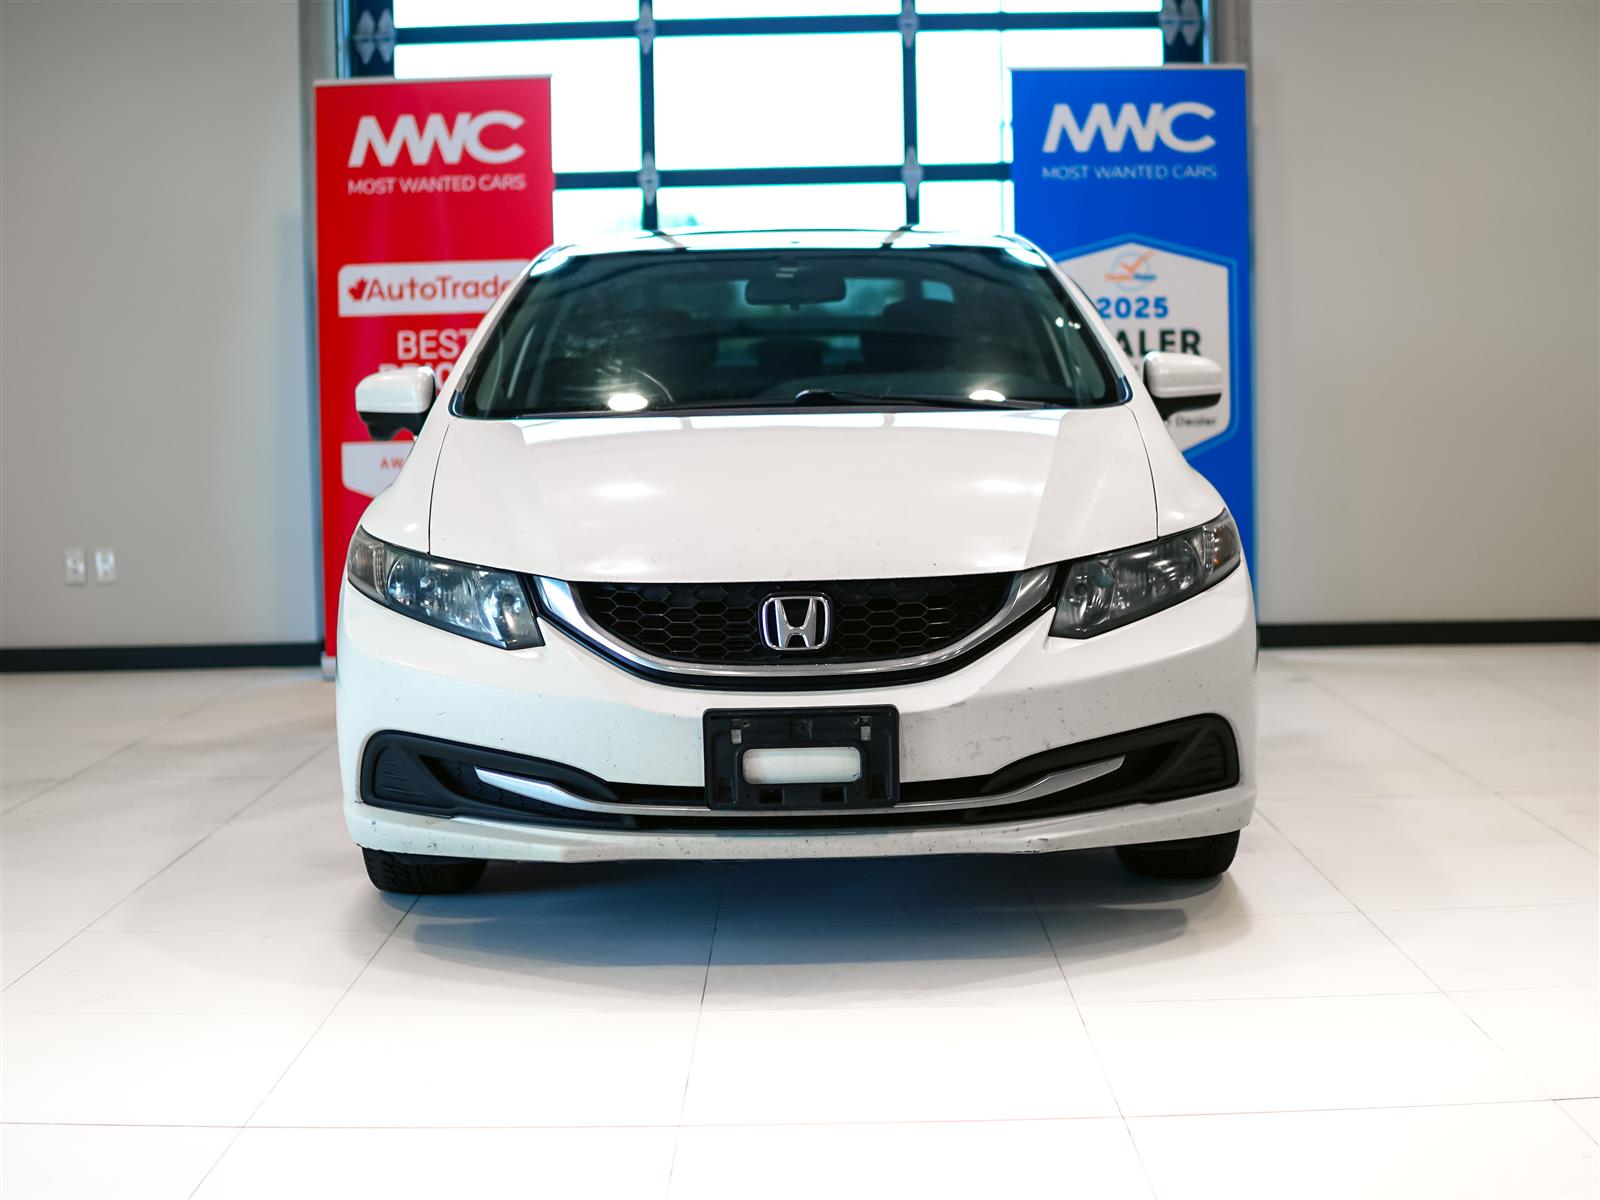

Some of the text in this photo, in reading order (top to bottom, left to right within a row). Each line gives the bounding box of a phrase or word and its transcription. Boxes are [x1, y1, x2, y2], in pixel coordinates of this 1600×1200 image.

[348, 110, 526, 168] MWC
[1042, 101, 1217, 153] MWC
[348, 174, 527, 195] MOST WANTED CARS
[1042, 164, 1218, 180] MOST WANTED CARS
[1098, 296, 1169, 319] 2025
[397, 328, 477, 360] BEST
